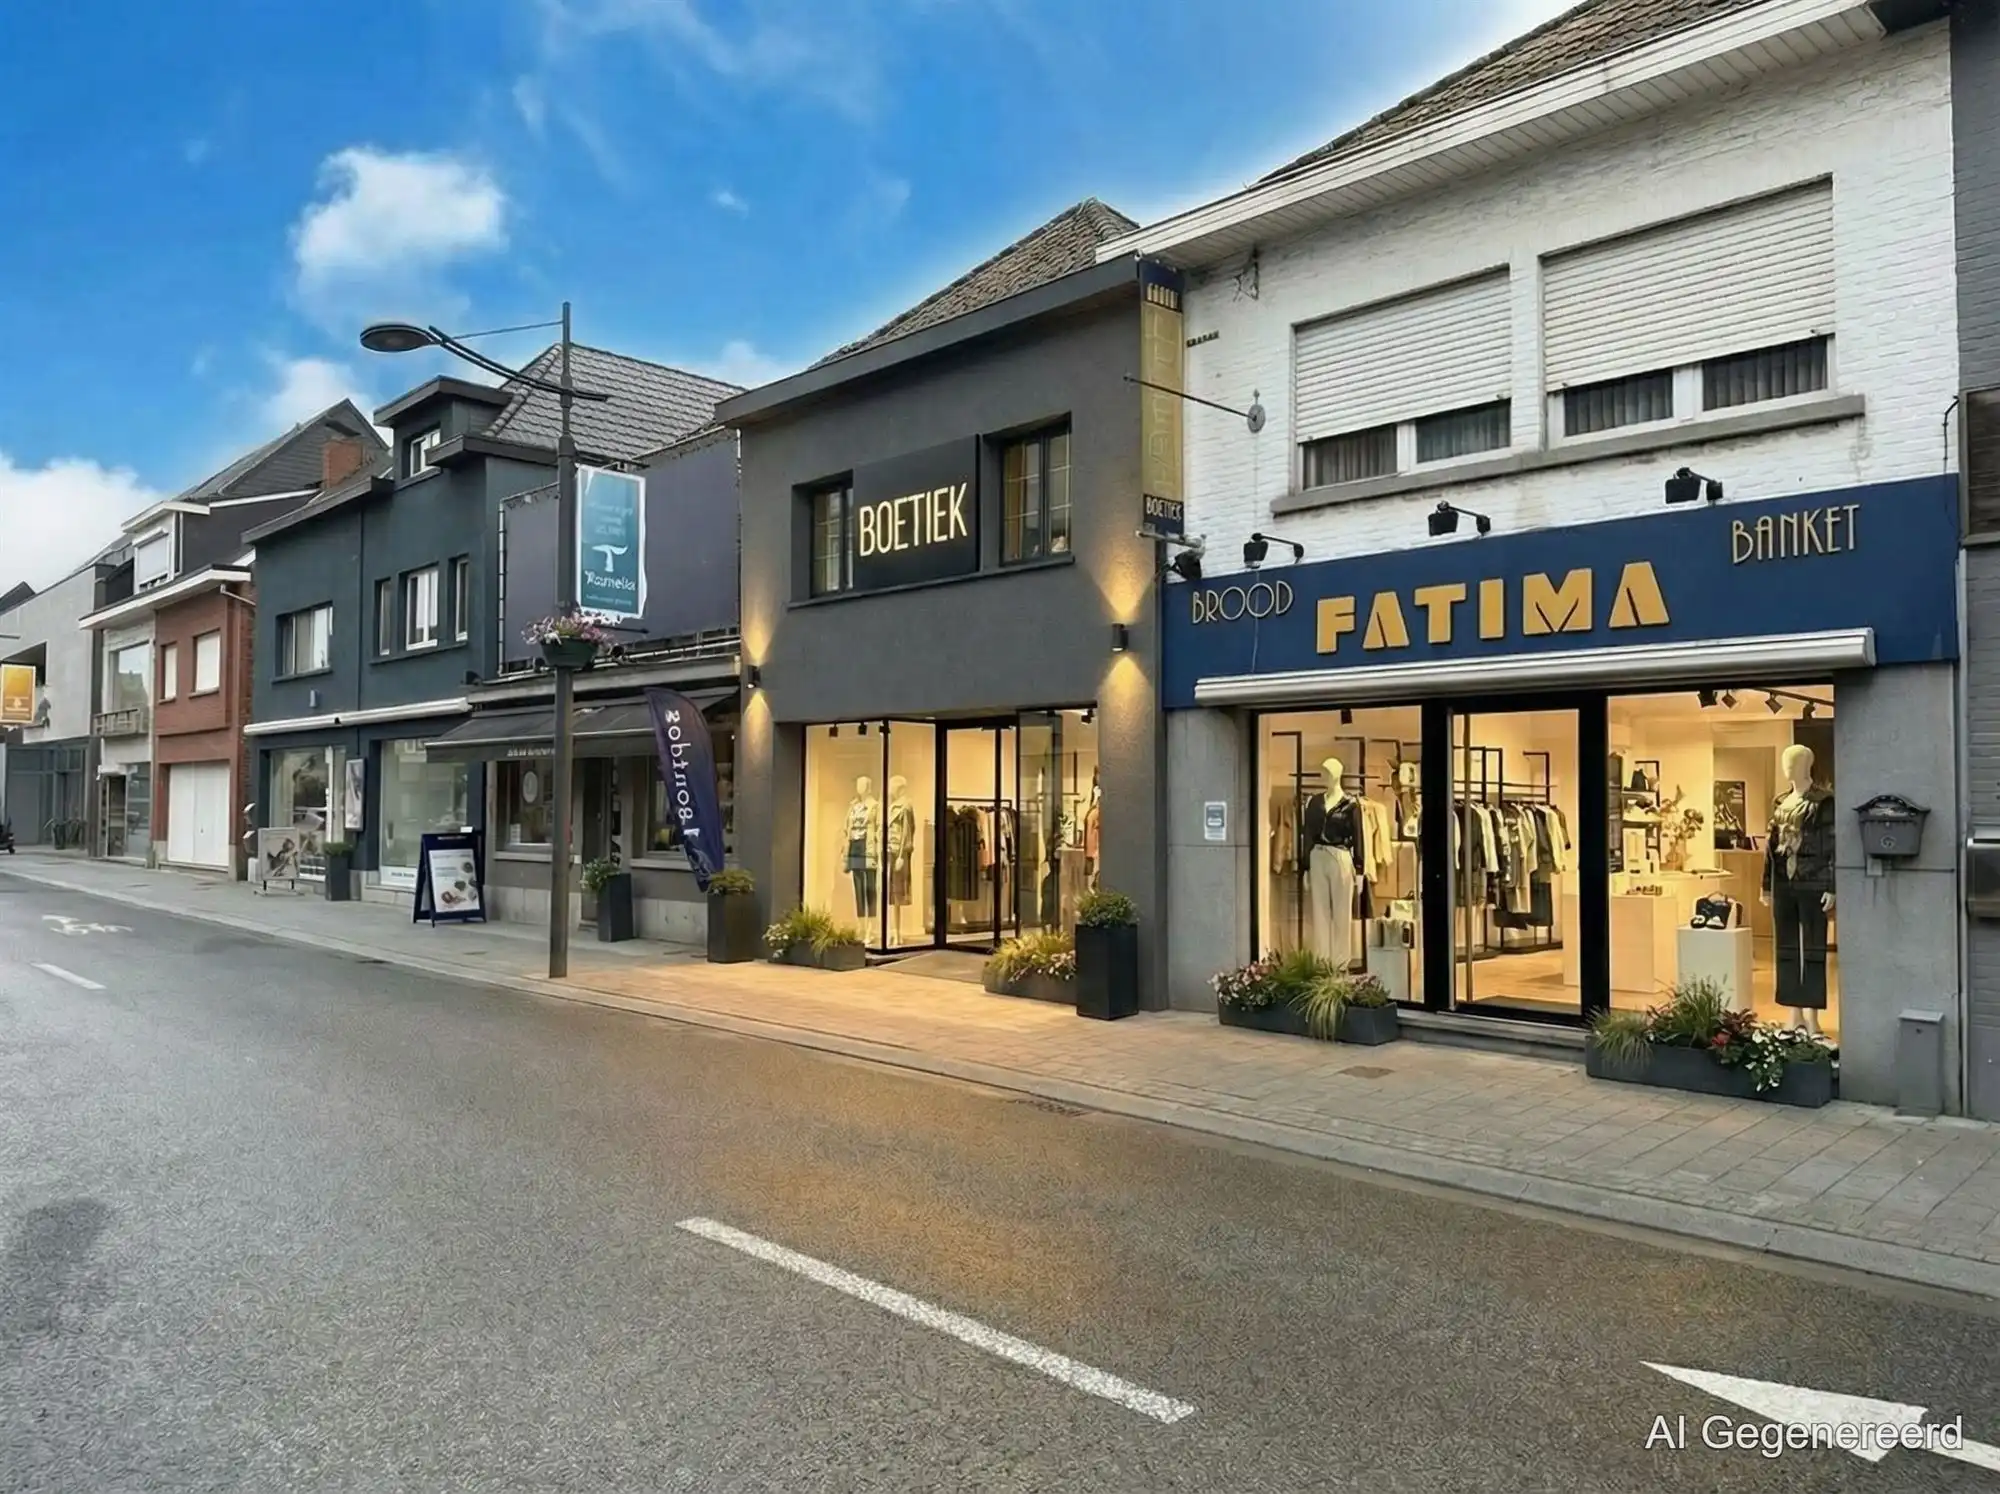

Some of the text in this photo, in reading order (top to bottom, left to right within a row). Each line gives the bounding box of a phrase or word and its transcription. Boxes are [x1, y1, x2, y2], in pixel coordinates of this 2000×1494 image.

[859, 482, 968, 558] BOETIEK
[1731, 503, 1861, 564] BANKET
[1191, 579, 1294, 624] BROOD
[1315, 560, 1670, 654] FATIMA
